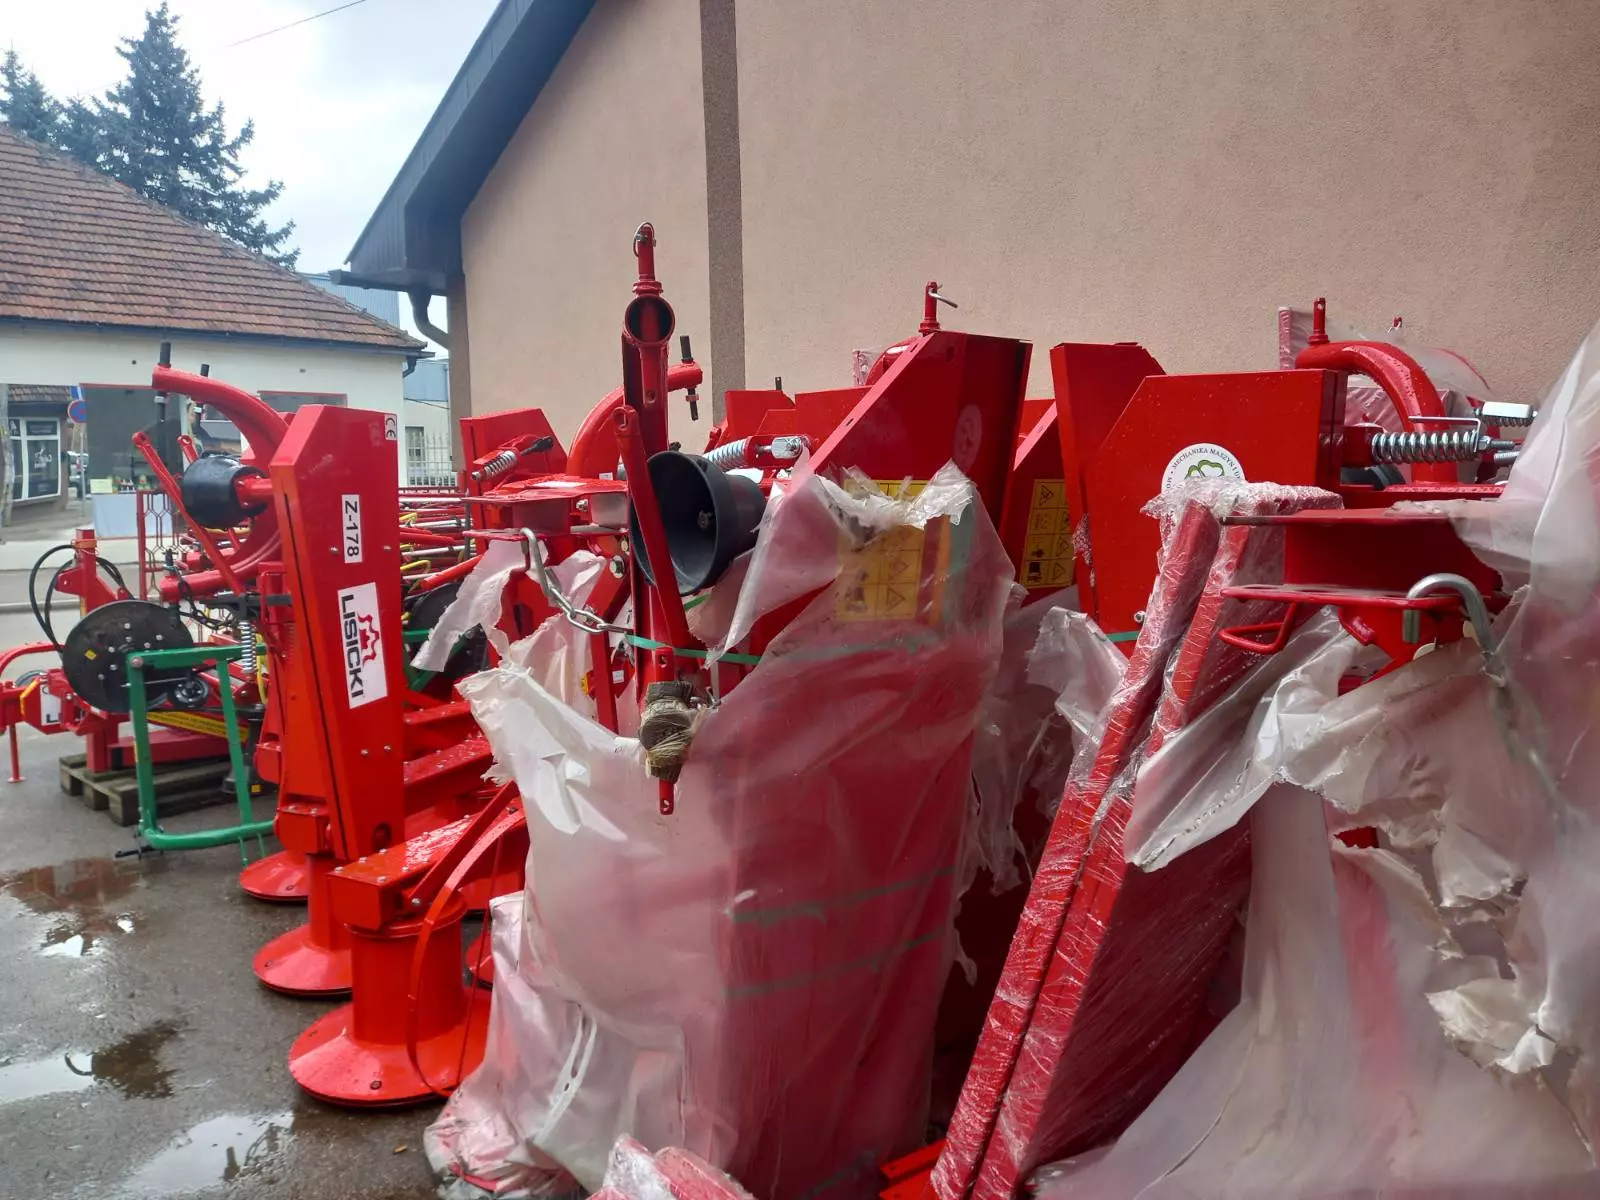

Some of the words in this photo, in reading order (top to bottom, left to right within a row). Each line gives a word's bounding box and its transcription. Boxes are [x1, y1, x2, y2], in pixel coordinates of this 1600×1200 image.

[1172, 448, 1208, 469] MECHANIKA
[1209, 448, 1234, 468] MASZYN
[344, 500, 360, 557] Z-178
[341, 593, 364, 699] LISICKI
